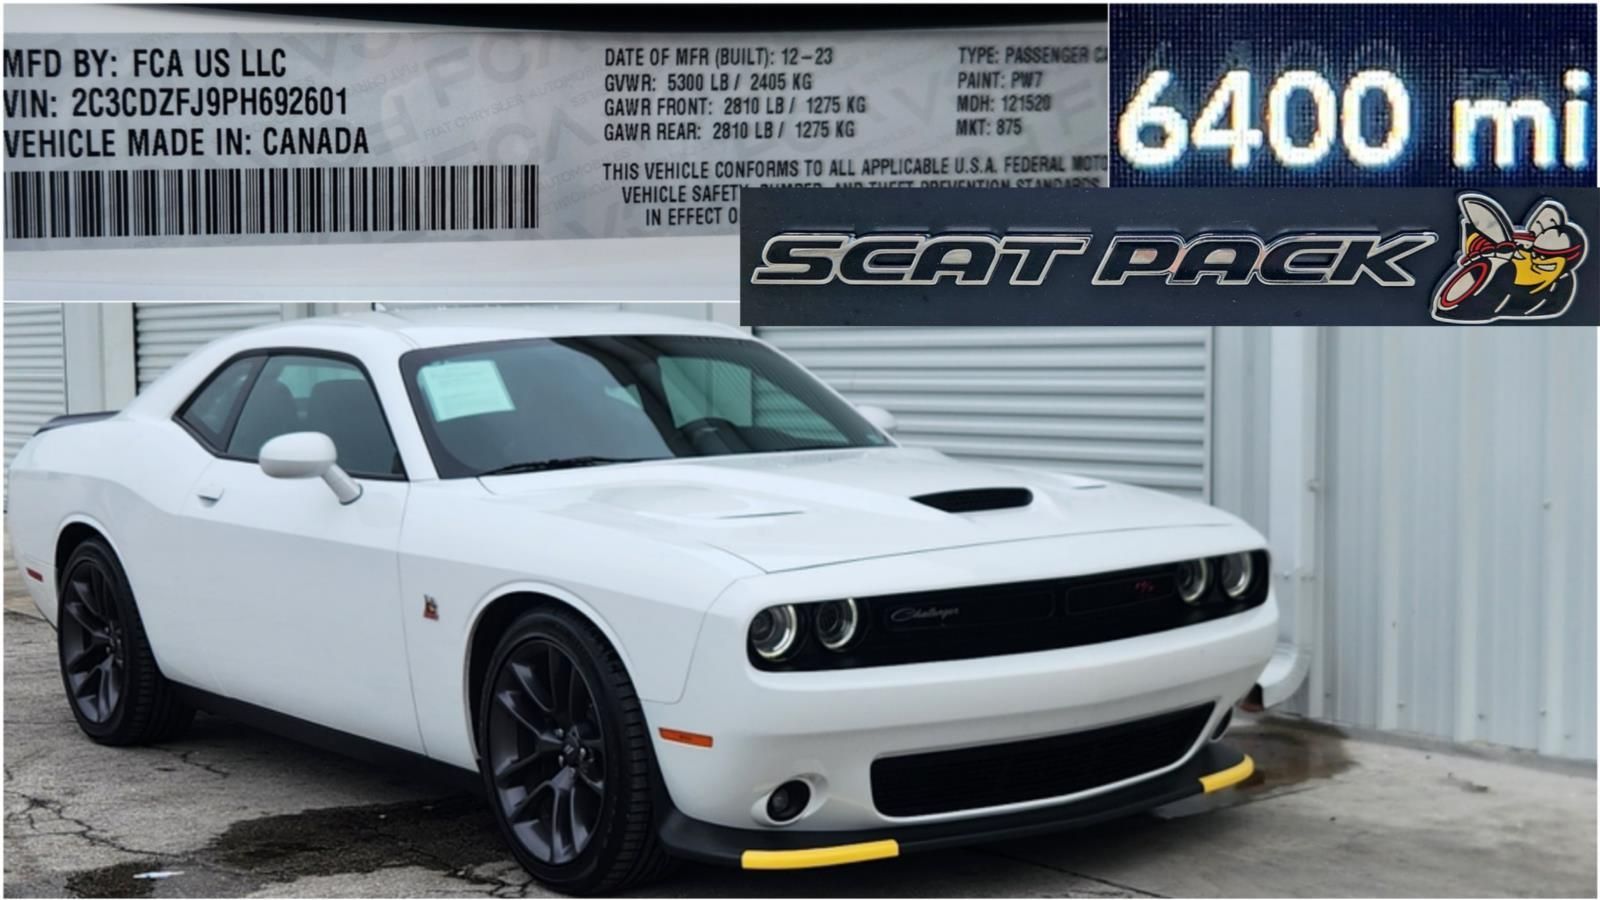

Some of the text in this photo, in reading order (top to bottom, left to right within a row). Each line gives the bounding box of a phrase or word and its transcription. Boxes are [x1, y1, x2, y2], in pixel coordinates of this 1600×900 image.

[3, 48, 286, 78] MFD BY: FCA US LLC
[605, 48, 644, 66] DATE
[650, 47, 670, 65] OF
[676, 47, 709, 66] MFR
[715, 47, 775, 69] (BUILT):
[958, 46, 999, 64] TYPE:
[1005, 45, 1089, 64] PASSENGER
[605, 74, 656, 92] GVWR:
[668, 73, 704, 91] 5300
[710, 73, 729, 91] LB
[750, 73, 786, 91] 2405
[792, 72, 812, 90] KG
[957, 71, 1044, 89] PAINT: PW7
[3, 86, 346, 118] VIN: 2C3CDZFJ9PH692601
[604, 98, 651, 116] GAWR
[657, 97, 712, 116] FRONT:
[724, 97, 760, 115] 2810
[766, 97, 784, 115] LB
[806, 96, 841, 114] 1275
[846, 95, 866, 113] KG
[956, 94, 1053, 112] MDH: 121520
[955, 118, 1022, 136] MKT: 875
[1118, 68, 1591, 169] 6400 mi
[603, 123, 651, 141] GAWR
[657, 122, 702, 140] REAR:
[712, 121, 748, 140] 2810
[755, 121, 773, 139] LB
[795, 121, 830, 139] 1275
[835, 120, 855, 138] KG
[3, 126, 369, 158] VEHICLE MADE IN: CANADA
[602, 162, 640, 180] THIS
[644, 161, 709, 180] VEHICLE
[715, 160, 799, 179] CONFORMS
[804, 159, 823, 177] TO
[828, 159, 856, 176] ALL
[861, 157, 949, 176] APPLICABLE
[954, 156, 997, 174] U.S.A.
[1003, 155, 1066, 173] FEDERAL
[621, 185, 687, 204] VEHICLE
[691, 184, 748, 202] SAFET
[645, 208, 662, 226] IN
[668, 207, 723, 226] EFFECT
[750, 230, 1439, 286] SCAT PACK
